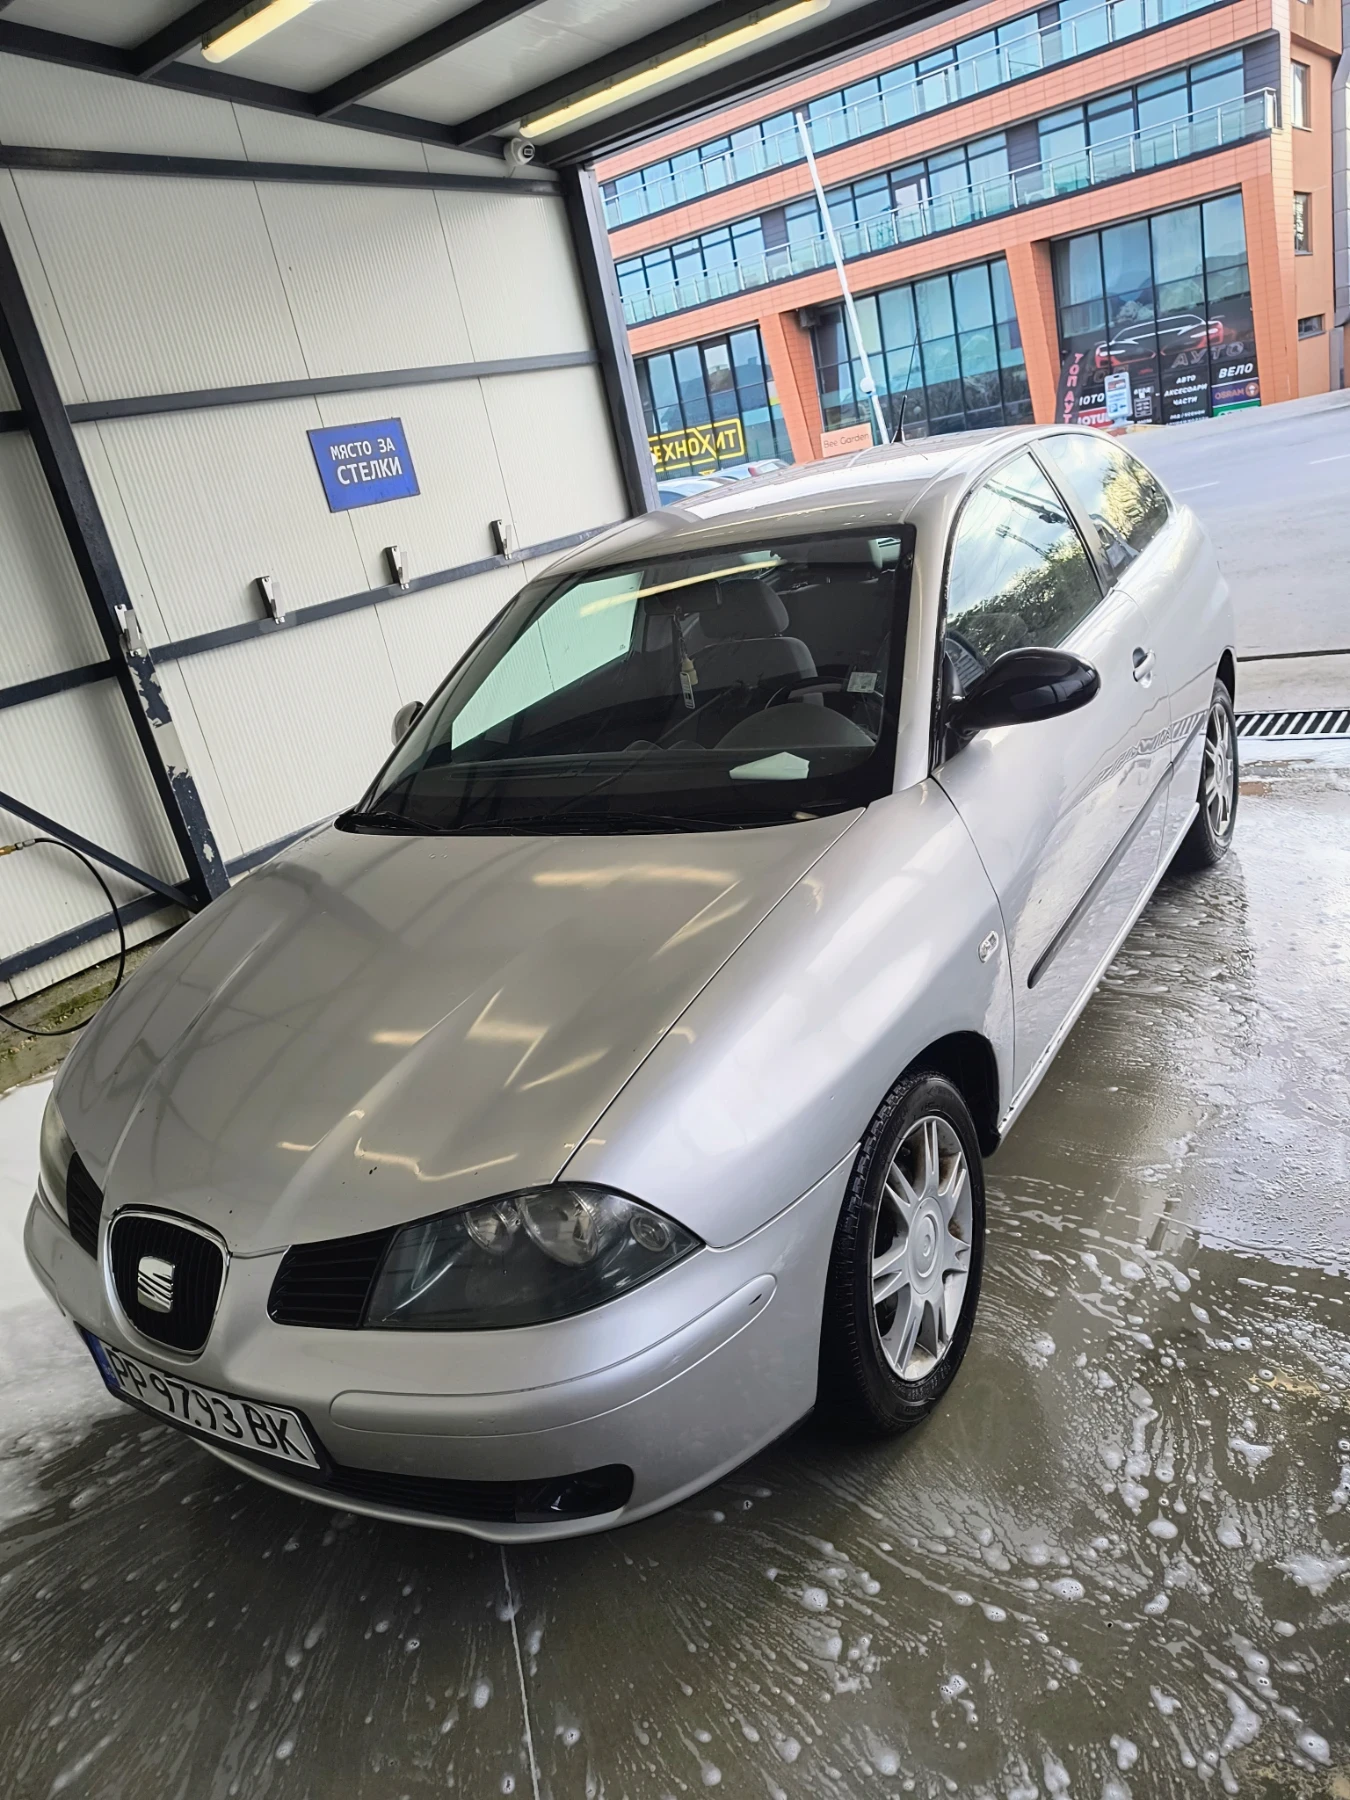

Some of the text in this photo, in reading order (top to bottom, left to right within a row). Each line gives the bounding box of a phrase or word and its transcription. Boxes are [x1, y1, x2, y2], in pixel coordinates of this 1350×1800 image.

[1066, 353, 1084, 388] ТОП
[1176, 374, 1196, 384] АВТО
[1218, 363, 1253, 379] ВЕЛО
[1173, 396, 1198, 406] ЧАСТИ
[1214, 388, 1244, 400] OSRAM
[330, 437, 396, 461] МЯСТО ЗА
[649, 428, 737, 463] ЕХНОХИТ
[824, 433, 870, 449] Bee Garden
[337, 456, 403, 485] СТЕЛКИ
[150, 1373, 244, 1439] 9793
